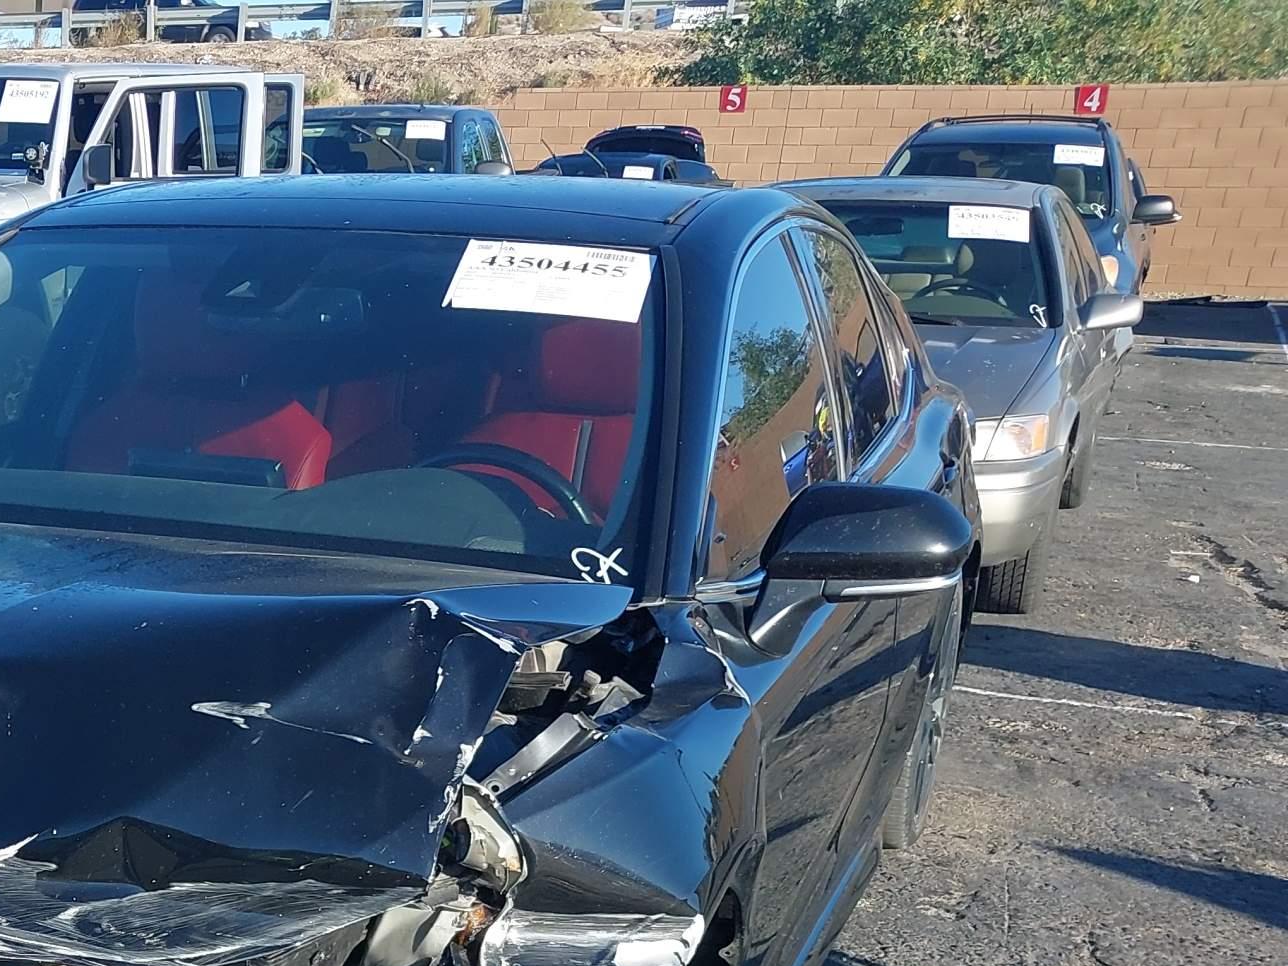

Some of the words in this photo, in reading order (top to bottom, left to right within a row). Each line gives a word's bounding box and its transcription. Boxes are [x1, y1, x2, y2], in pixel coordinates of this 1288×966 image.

[726, 87, 743, 111] 5
[1083, 87, 1102, 112] 4
[481, 254, 632, 279] 43504455
